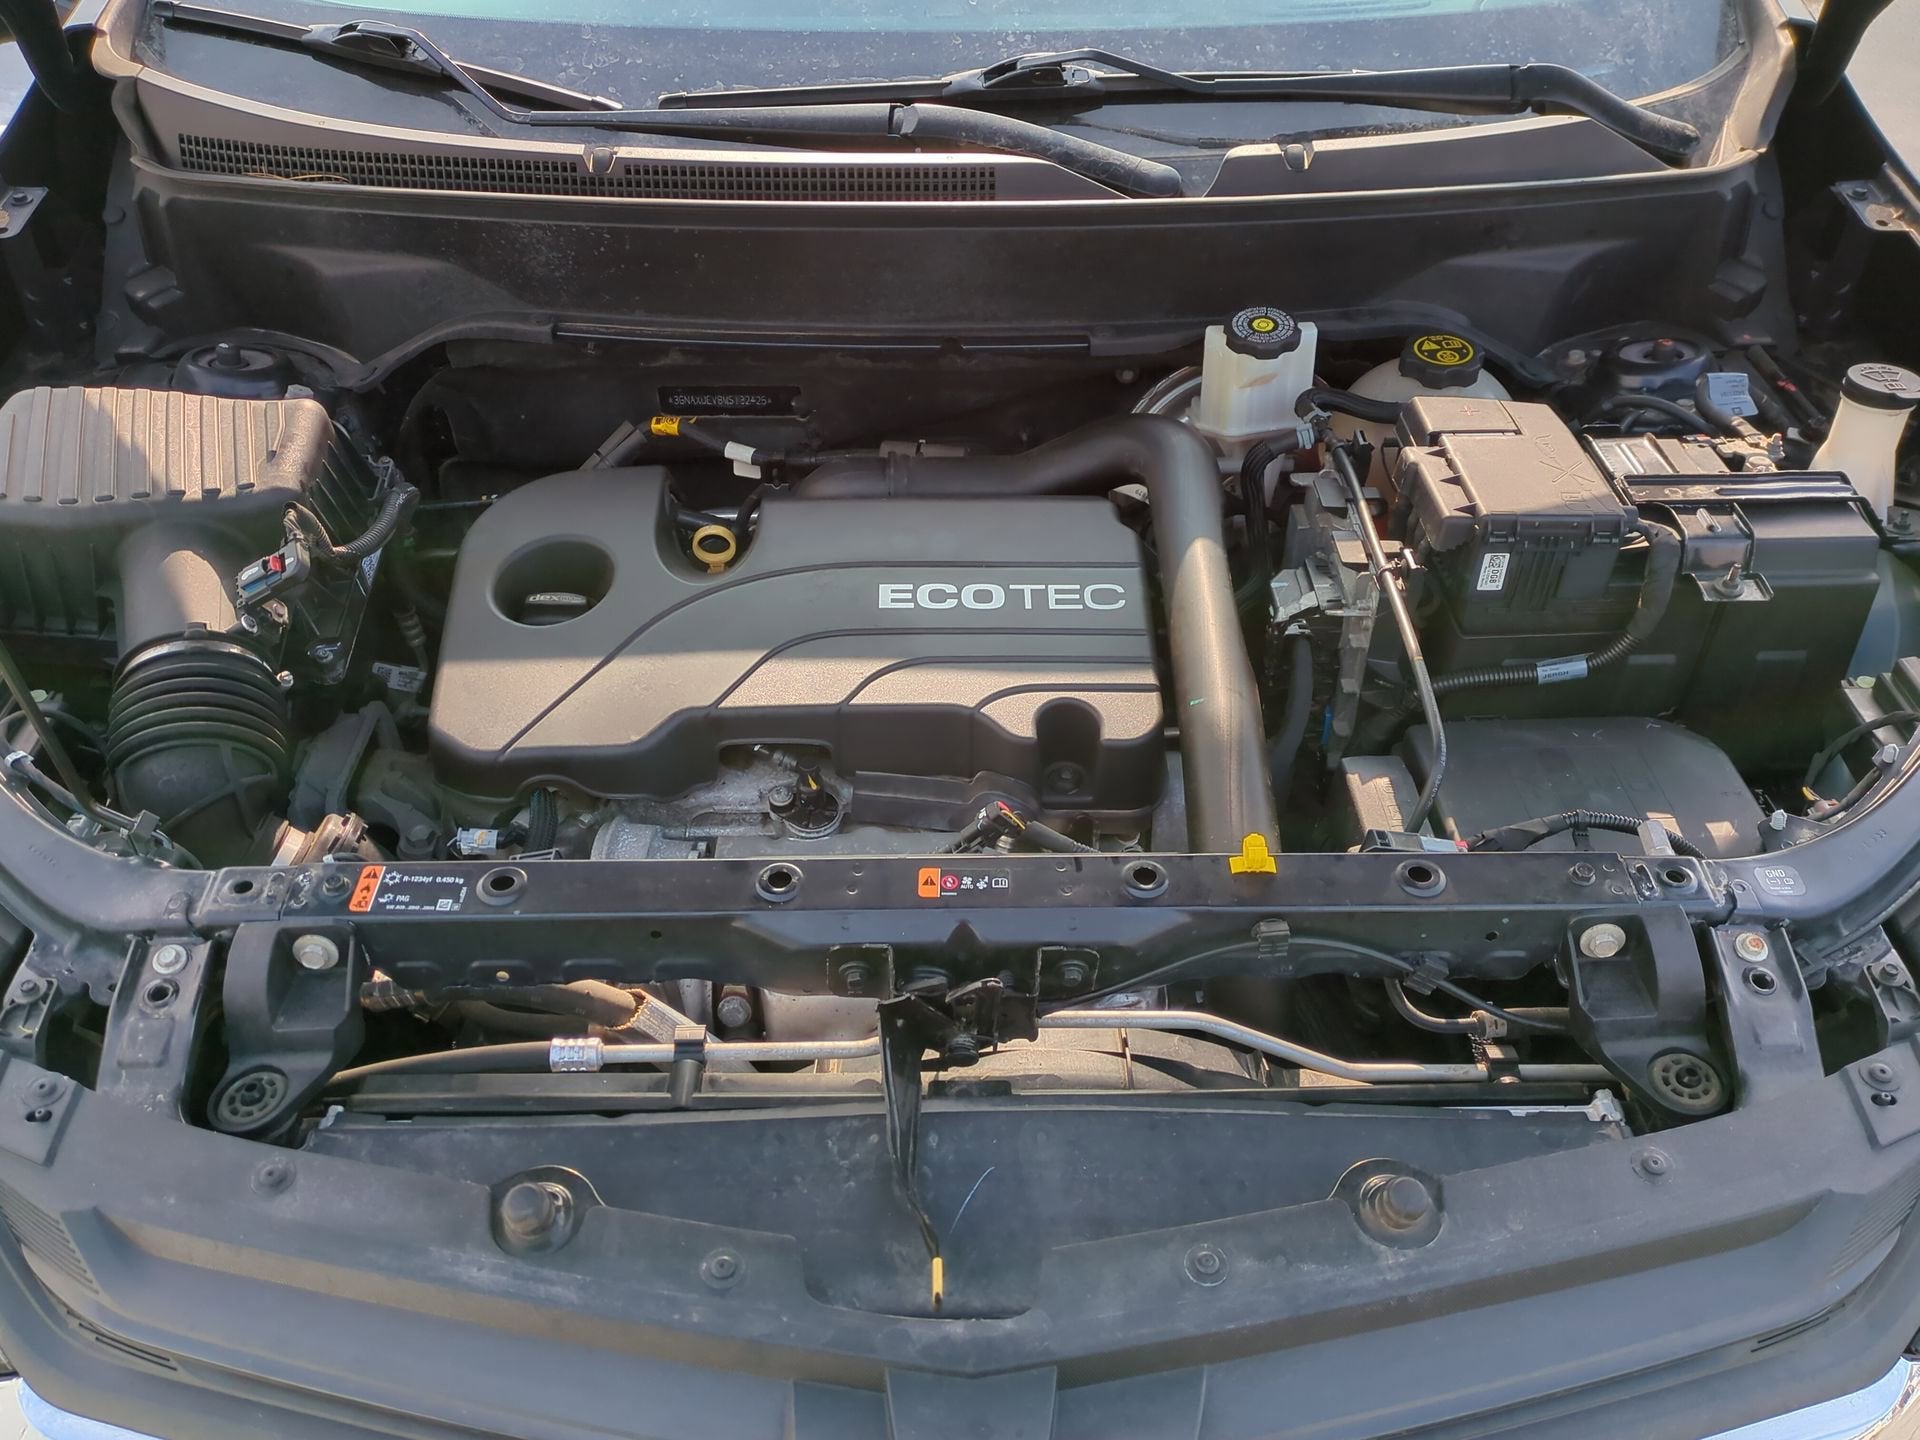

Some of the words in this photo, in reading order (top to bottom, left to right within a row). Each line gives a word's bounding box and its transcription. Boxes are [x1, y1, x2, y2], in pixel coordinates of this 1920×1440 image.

[878, 583, 1126, 610] ECOTEC
[1765, 869, 1786, 878] GND
[454, 876, 465, 885] kg
[395, 894, 411, 902] PAG
